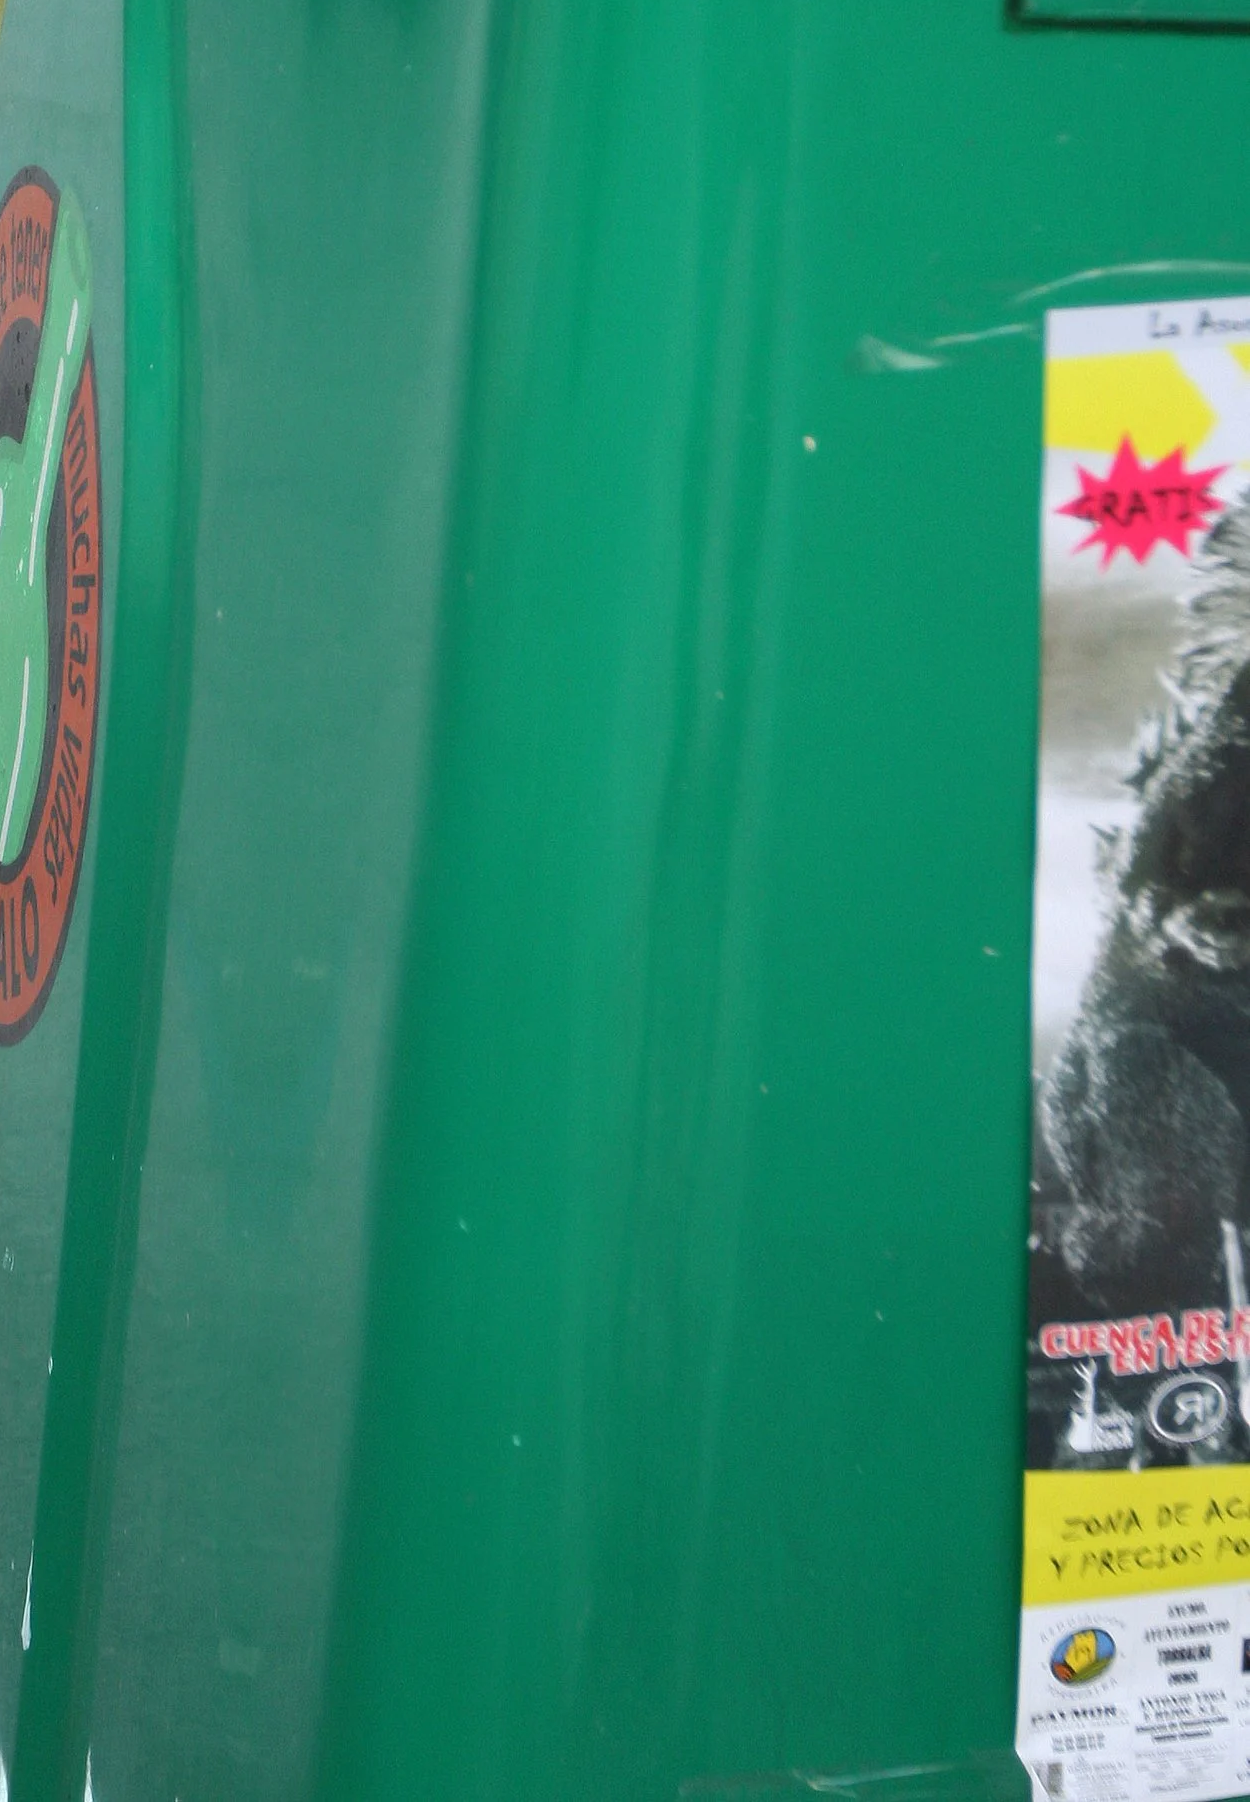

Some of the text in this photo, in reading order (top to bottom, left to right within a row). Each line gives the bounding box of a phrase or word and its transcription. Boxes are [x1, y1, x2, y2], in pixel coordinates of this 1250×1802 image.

[10, 214, 49, 302] tener
[66, 408, 96, 709] muchas
[44, 725, 83, 906] vidas
[1039, 1313, 1177, 1359] CUENCA
[1060, 1508, 1144, 1543] ZONA
[1156, 1501, 1192, 1528] DE
[1048, 1554, 1068, 1581] Y
[1079, 1540, 1205, 1578] PRECIOS
